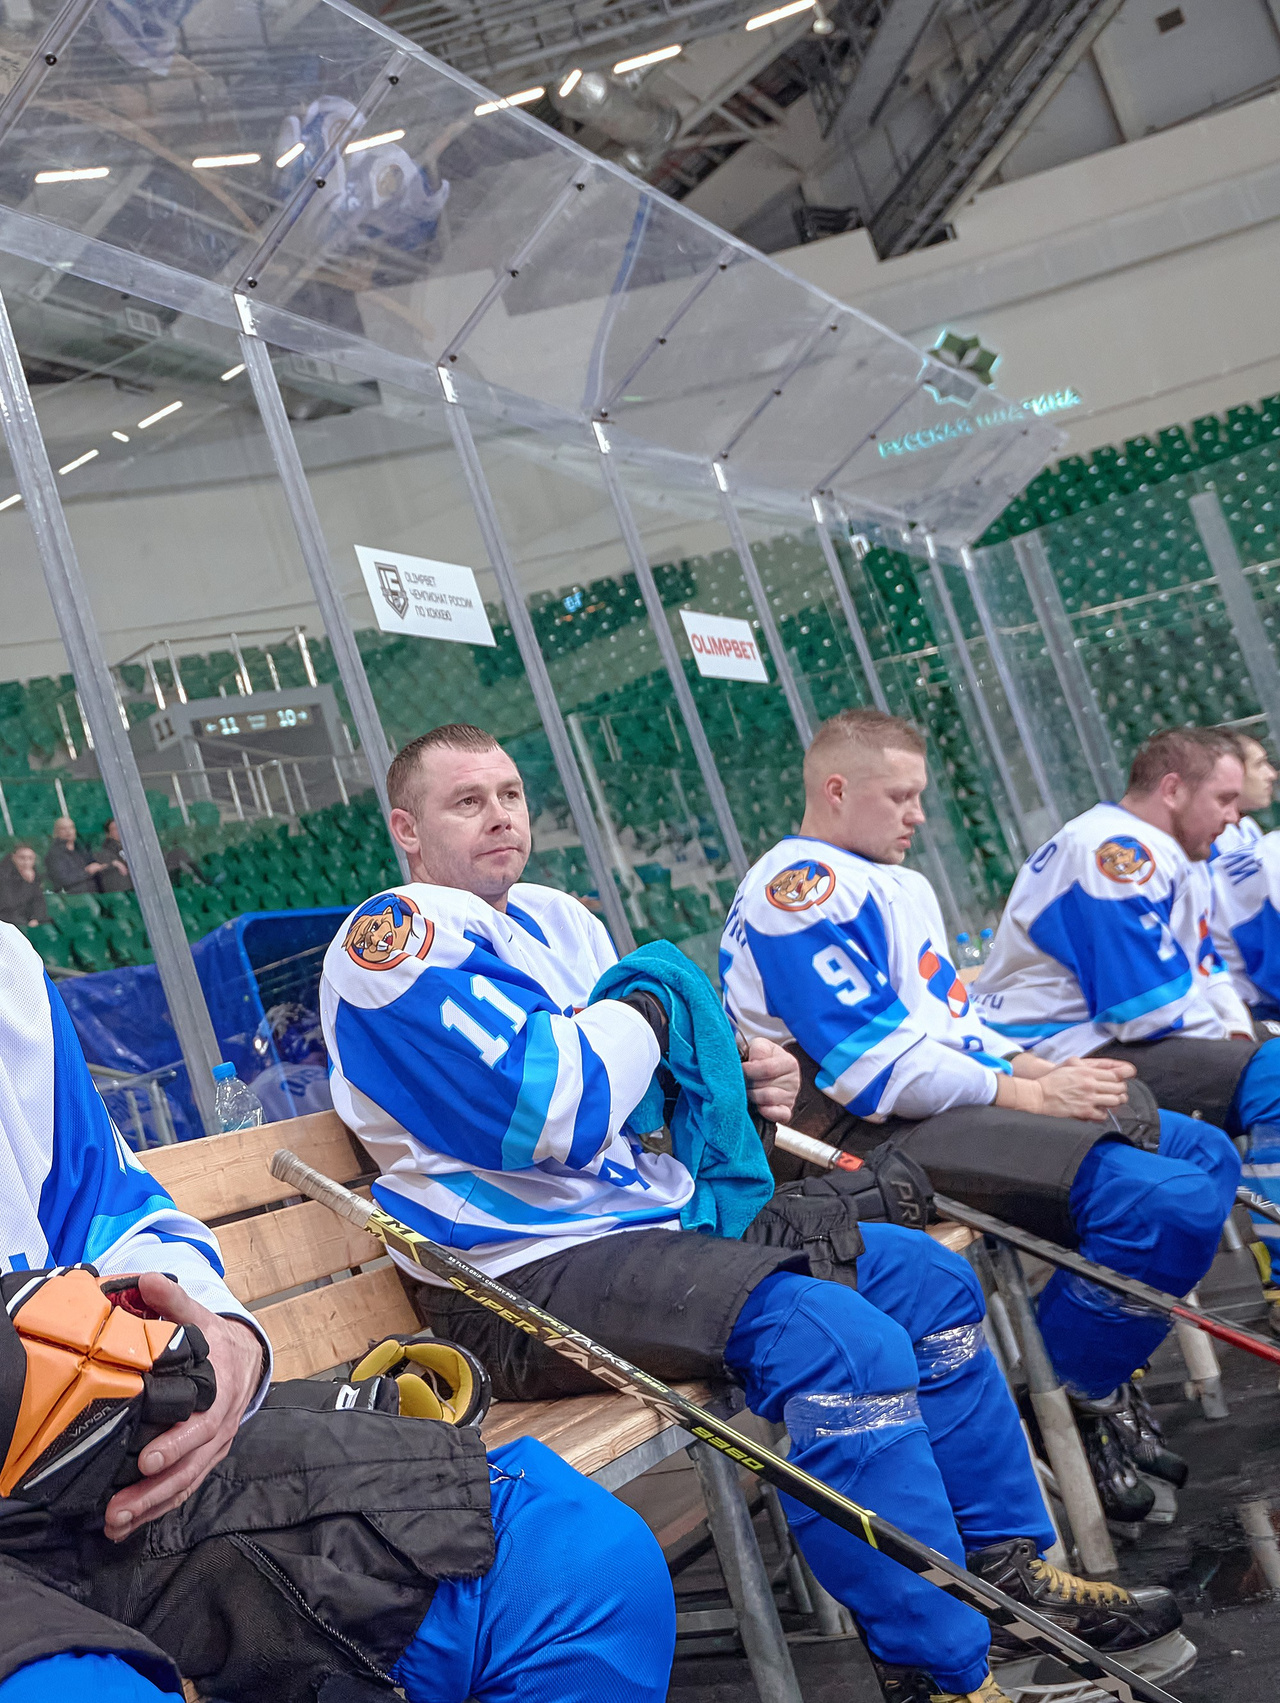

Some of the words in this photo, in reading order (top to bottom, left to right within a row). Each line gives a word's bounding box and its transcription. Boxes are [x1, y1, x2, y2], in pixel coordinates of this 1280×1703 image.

[404, 571, 437, 587] OLIMPBET
[410, 588, 449, 605] ЧЕМПИОНАТ
[449, 595, 474, 609] РОССИИ
[415, 605, 426, 618] ПО
[425, 607, 452, 622] ХОККЕЮ
[691, 633, 757, 661] OLIMPBET
[218, 716, 240, 736] 11
[276, 709, 297, 728] 10
[811, 939, 888, 1007] 9
[440, 974, 528, 1071] 11
[889, 1180, 922, 1225] PR
[448, 1276, 540, 1336] SUPER
[527, 1306, 570, 1333] SUPER
[564, 1330, 634, 1372] TACKS
